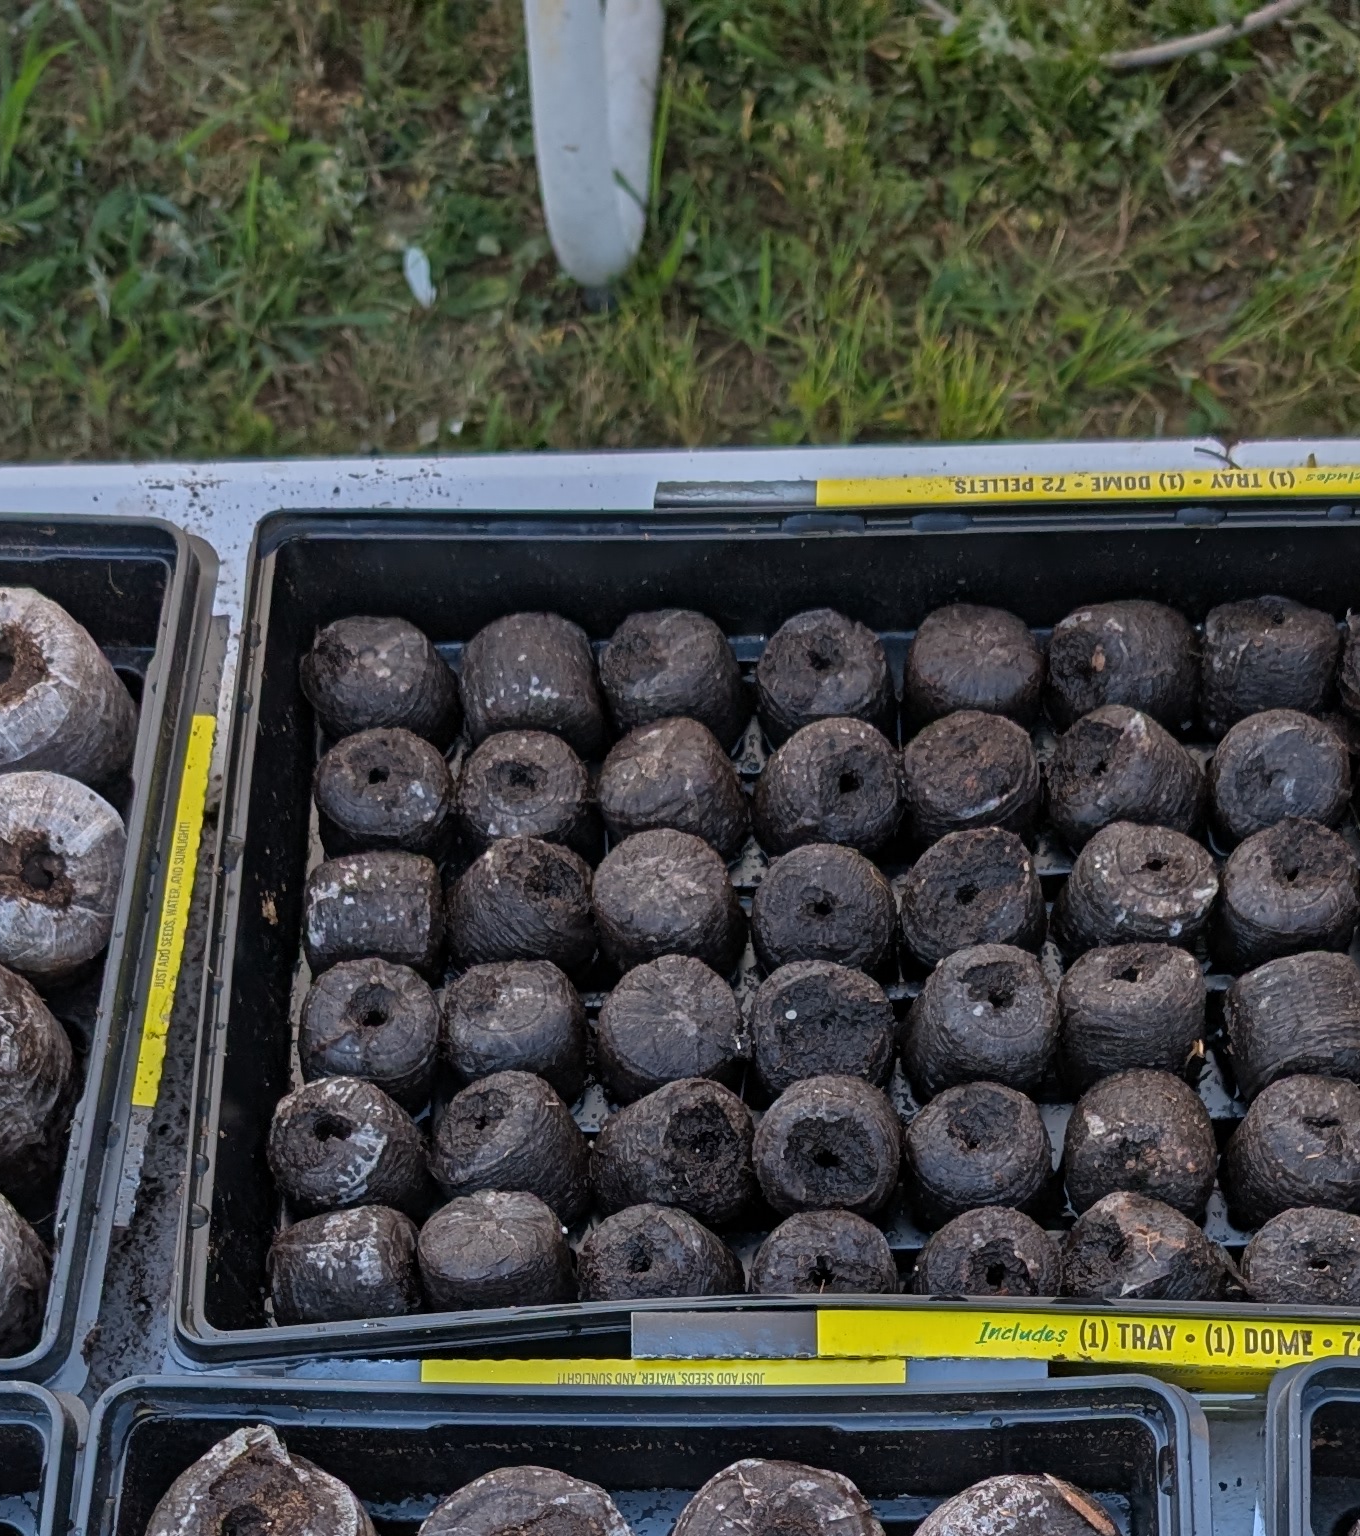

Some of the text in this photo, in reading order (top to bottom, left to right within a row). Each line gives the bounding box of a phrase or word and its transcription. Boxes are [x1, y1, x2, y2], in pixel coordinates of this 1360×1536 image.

[954, 477, 1034, 494] PELLETS
[1041, 477, 1067, 493] 72
[1091, 475, 1151, 492] DOME
[1159, 474, 1185, 492] (1)
[1211, 473, 1263, 489] TRAY
[1269, 471, 1295, 489] (1)
[170, 865, 183, 885] AND
[158, 949, 170, 967] ADD
[154, 967, 168, 989] JUST
[975, 1321, 1068, 1344] Includes
[1079, 1318, 1109, 1351] (1)
[1117, 1322, 1176, 1351] TRAY
[1205, 1324, 1235, 1357] (1)
[1244, 1328, 1314, 1356] DOME
[557, 1371, 765, 1385] JUST ADD SEEDS, WATER, AND SUNLIGHT!
